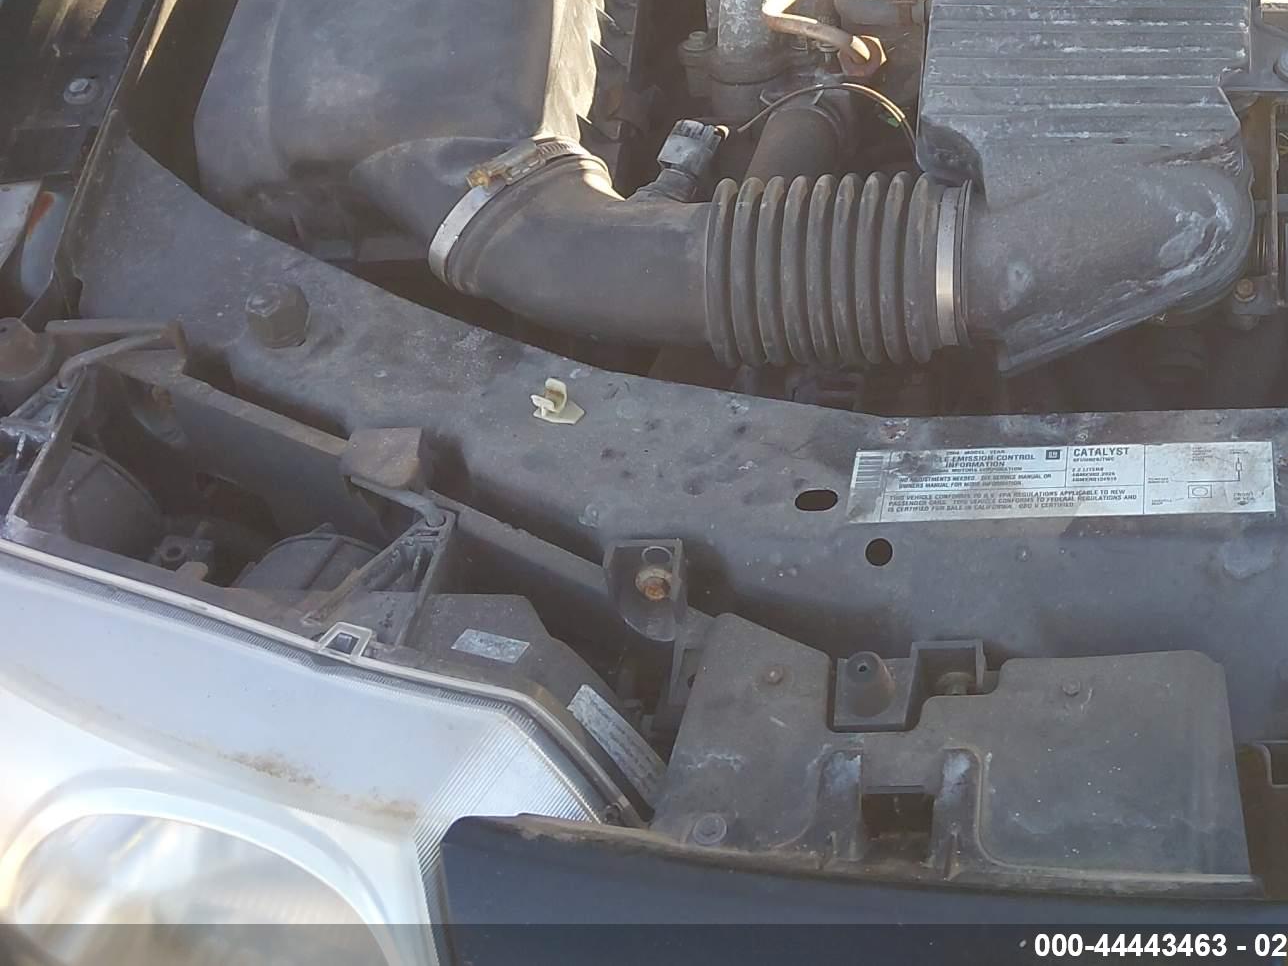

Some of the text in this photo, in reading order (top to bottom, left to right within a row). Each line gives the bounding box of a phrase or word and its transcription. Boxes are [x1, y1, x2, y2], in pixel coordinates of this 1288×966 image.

[1073, 446, 1130, 457] CATALYST
[951, 455, 992, 463] EMISSION
[997, 454, 1036, 462] CONTROL
[945, 461, 1006, 469] INFORMATION
